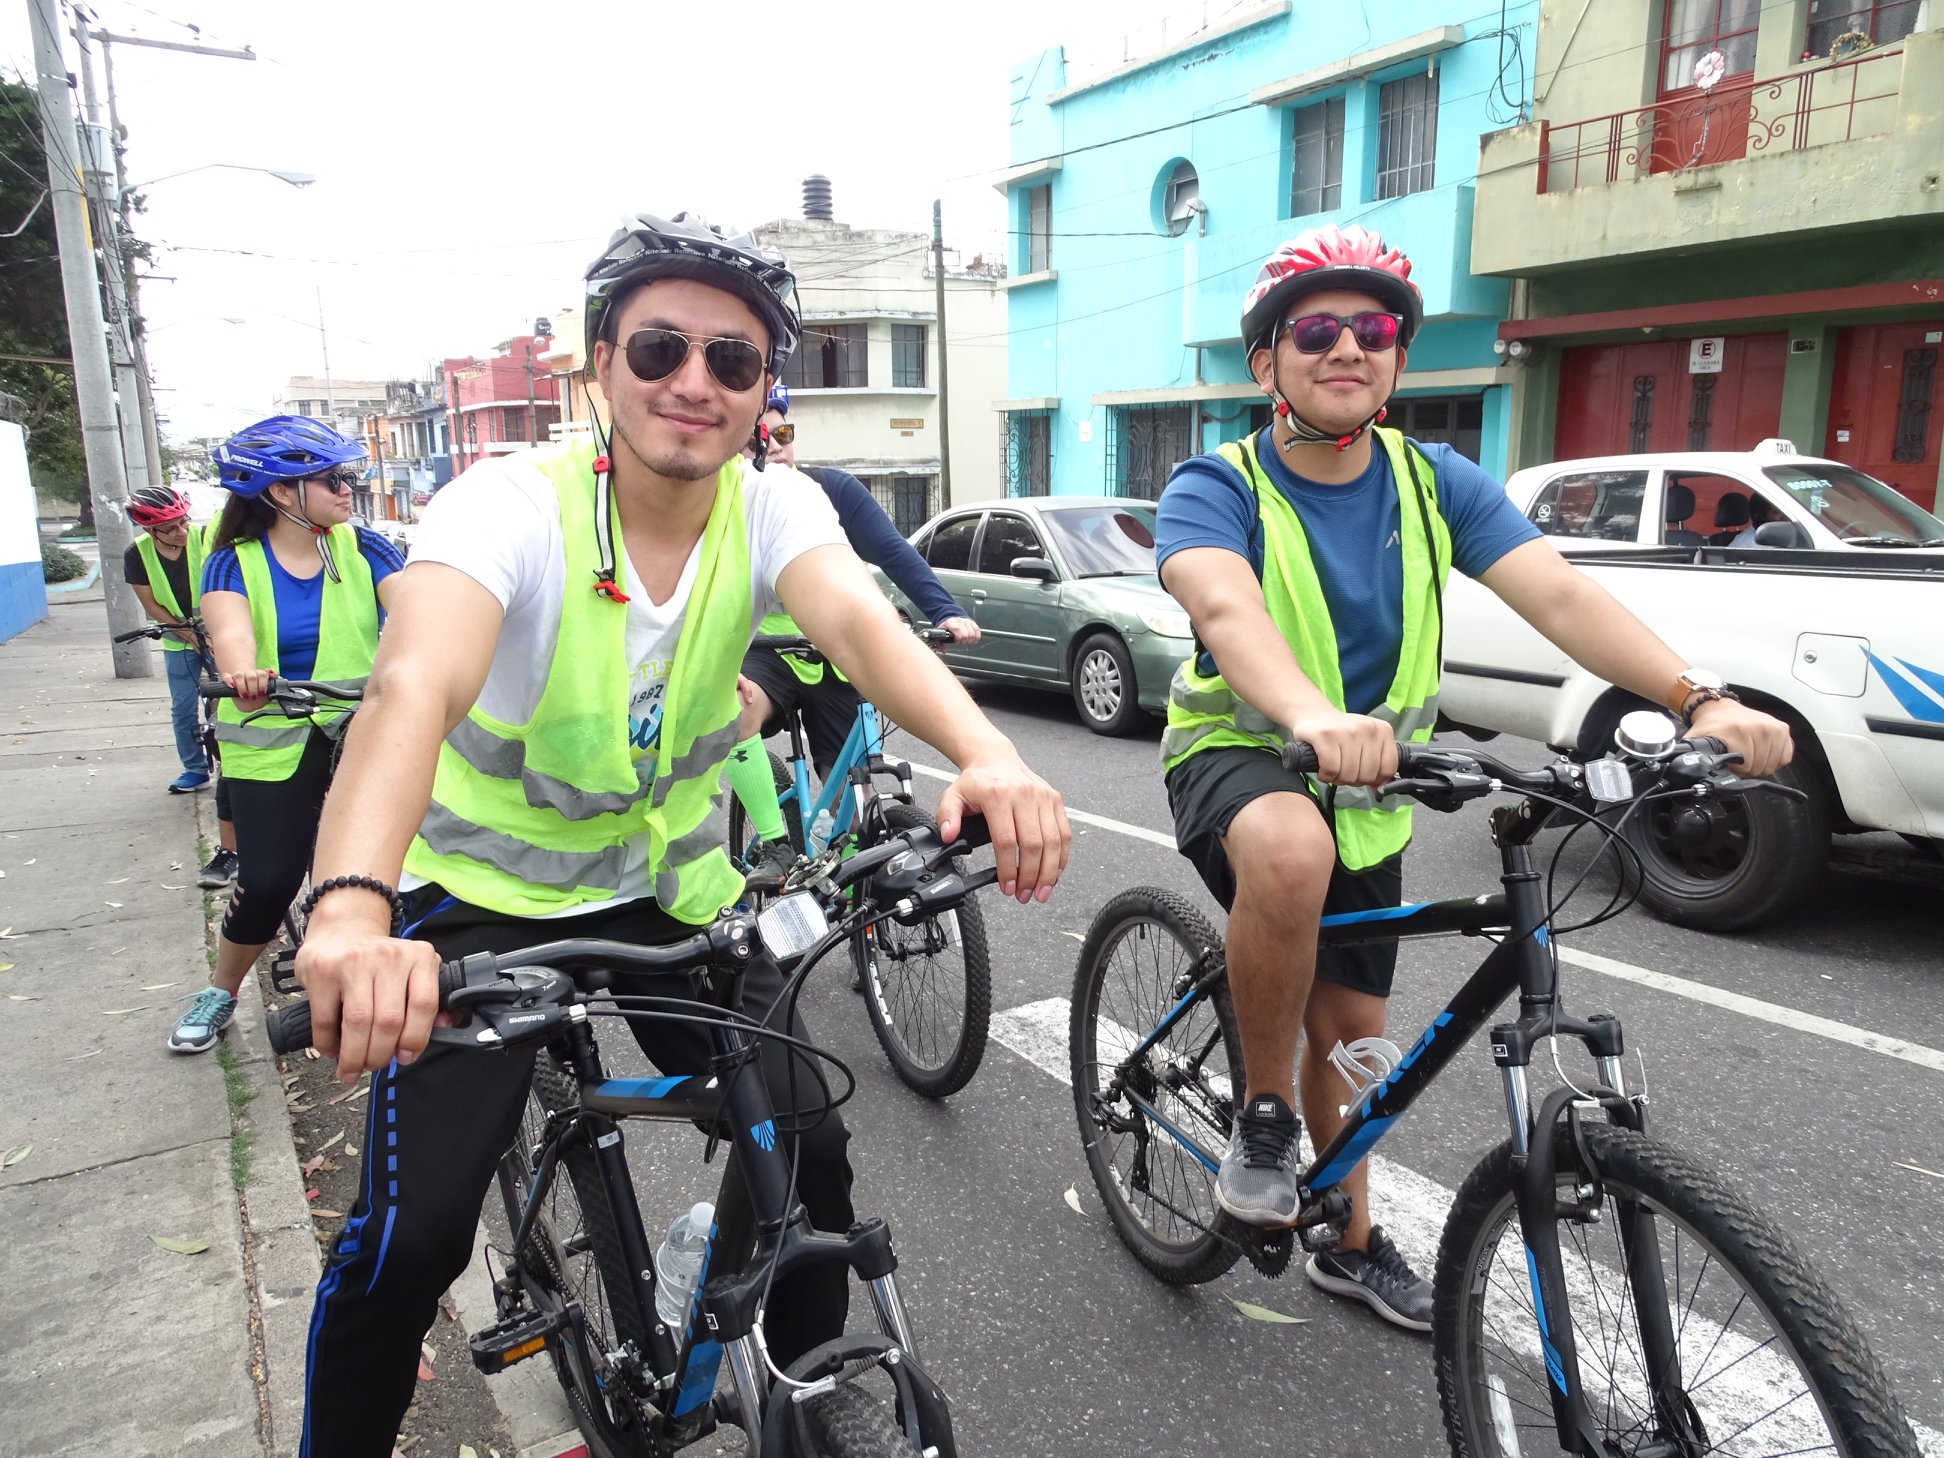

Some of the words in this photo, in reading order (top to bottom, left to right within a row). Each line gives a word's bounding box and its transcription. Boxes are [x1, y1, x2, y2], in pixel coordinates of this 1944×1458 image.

[1702, 343, 1713, 356] E
[1776, 443, 1791, 454] TAXI
[230, 454, 264, 468] PROWELL
[630, 683, 664, 707] 1987
[508, 1013, 546, 1024] SHIMANO
[1258, 1103, 1274, 1112] NIKE
[1442, 1355, 1470, 1458] ONTRAGER
